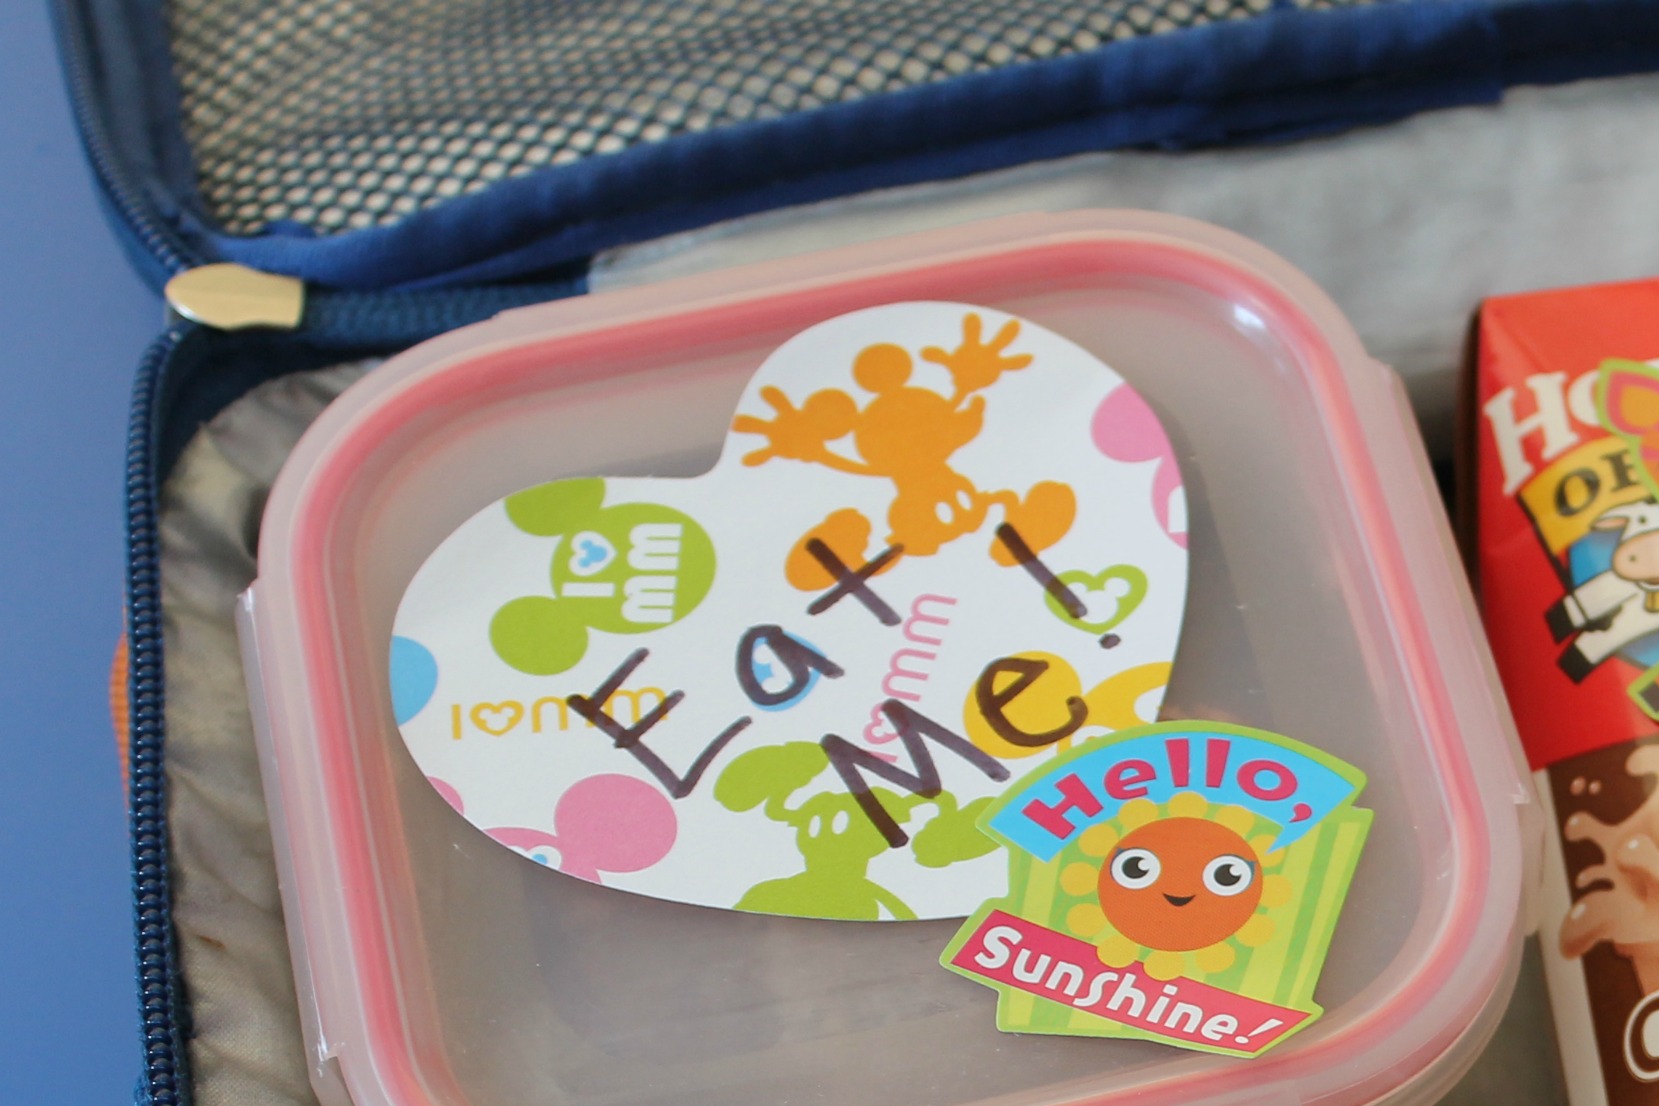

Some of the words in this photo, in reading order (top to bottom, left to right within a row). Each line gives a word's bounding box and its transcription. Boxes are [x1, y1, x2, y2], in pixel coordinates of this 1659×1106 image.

[567, 537, 904, 799] Eat
[1021, 738, 1313, 840] Hello,
[973, 925, 1284, 1044] Sunshine!
